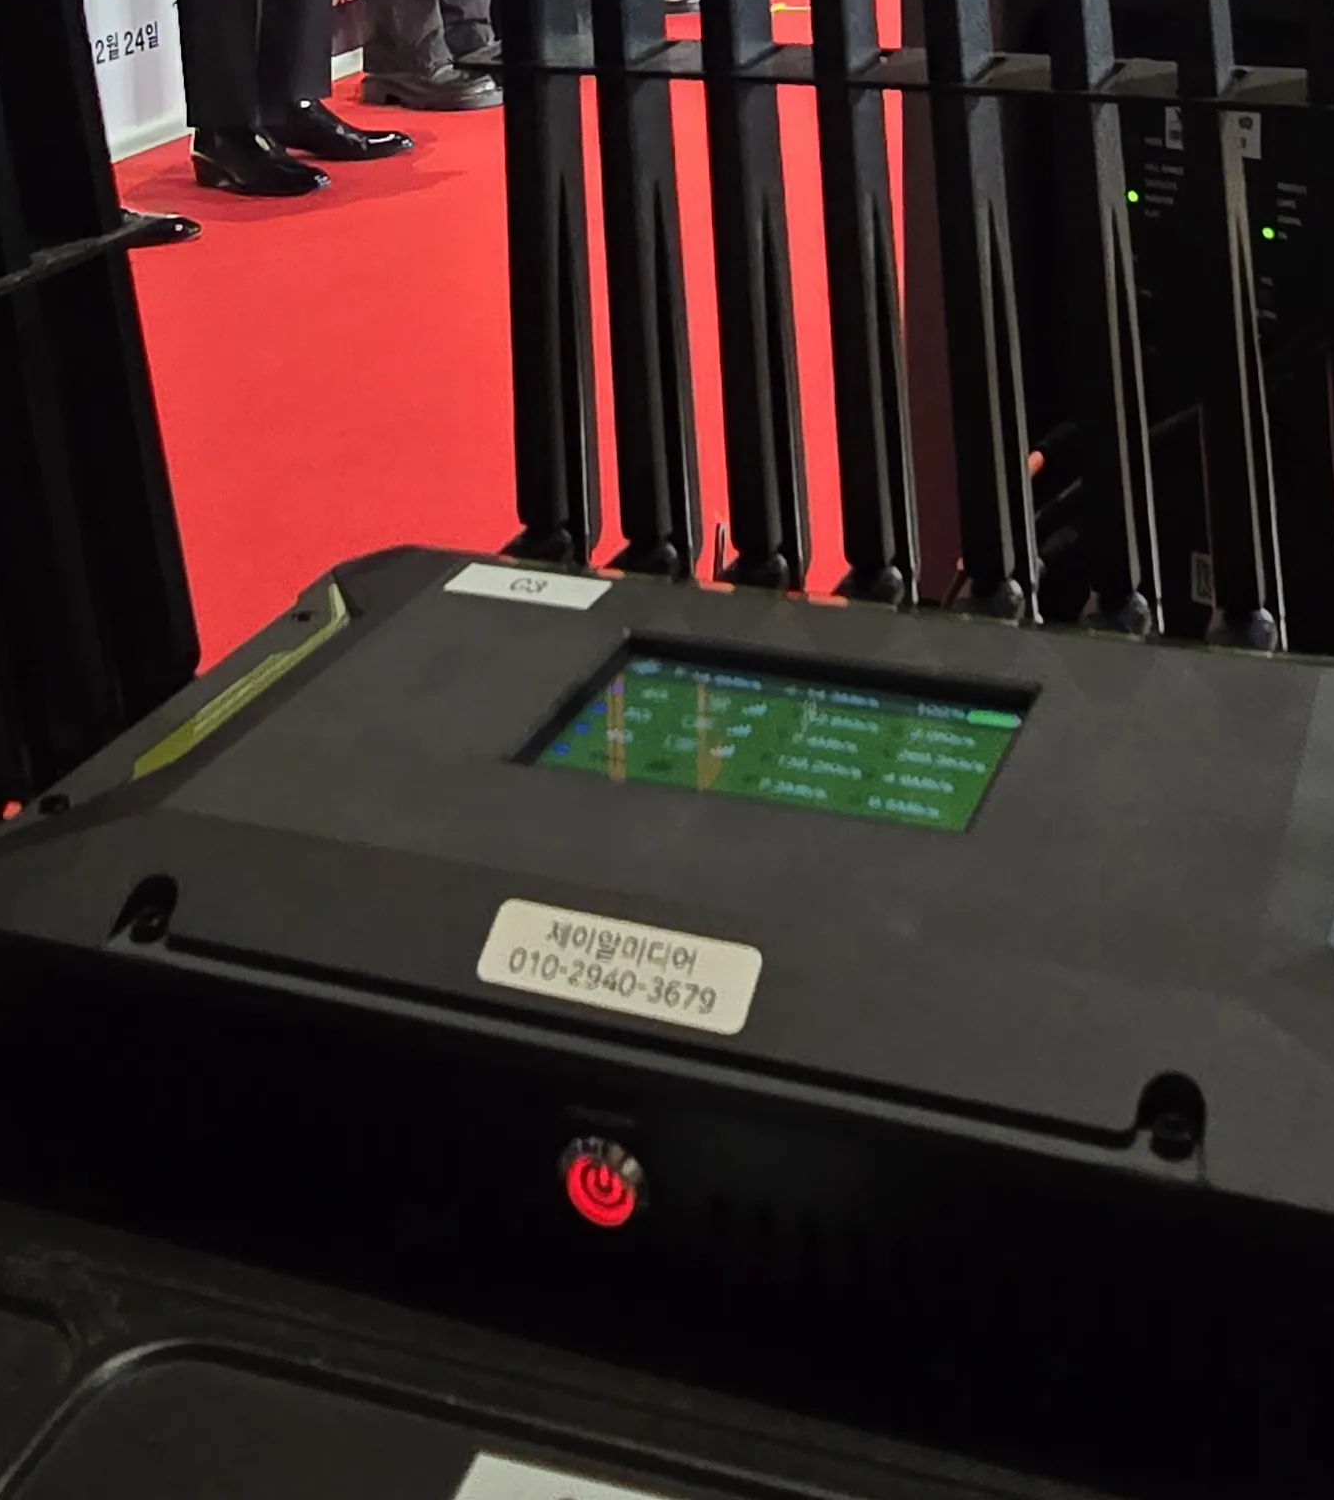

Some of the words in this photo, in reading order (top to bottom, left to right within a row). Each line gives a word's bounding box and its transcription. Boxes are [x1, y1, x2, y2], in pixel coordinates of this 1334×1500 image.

[95, 32, 120, 65] 2월
[124, 21, 159, 56] 24일
[546, 920, 698, 975] 제이알미디어
[509, 946, 717, 1005] 010-2940-3679
